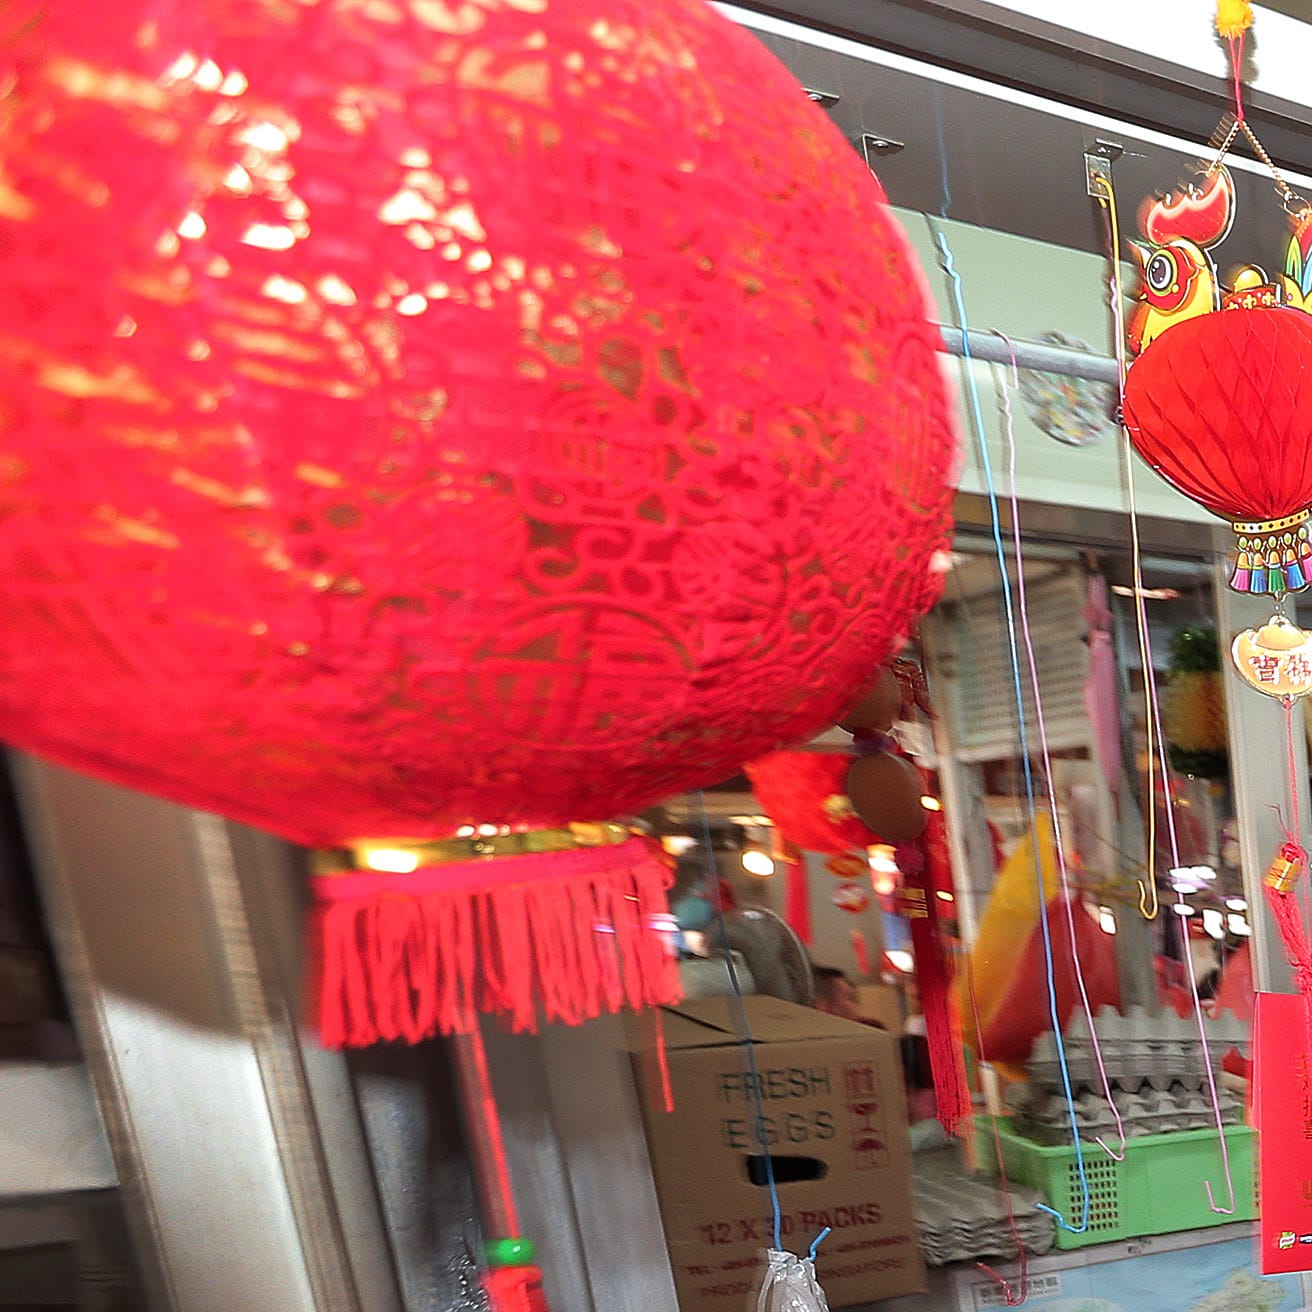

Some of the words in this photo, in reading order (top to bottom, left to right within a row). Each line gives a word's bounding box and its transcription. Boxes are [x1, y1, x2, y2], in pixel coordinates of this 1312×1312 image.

[721, 1067, 832, 1103] FRESH
[726, 1110, 836, 1149] EGGS
[702, 1221, 732, 1246] 12
[799, 1202, 882, 1233] PACKS
